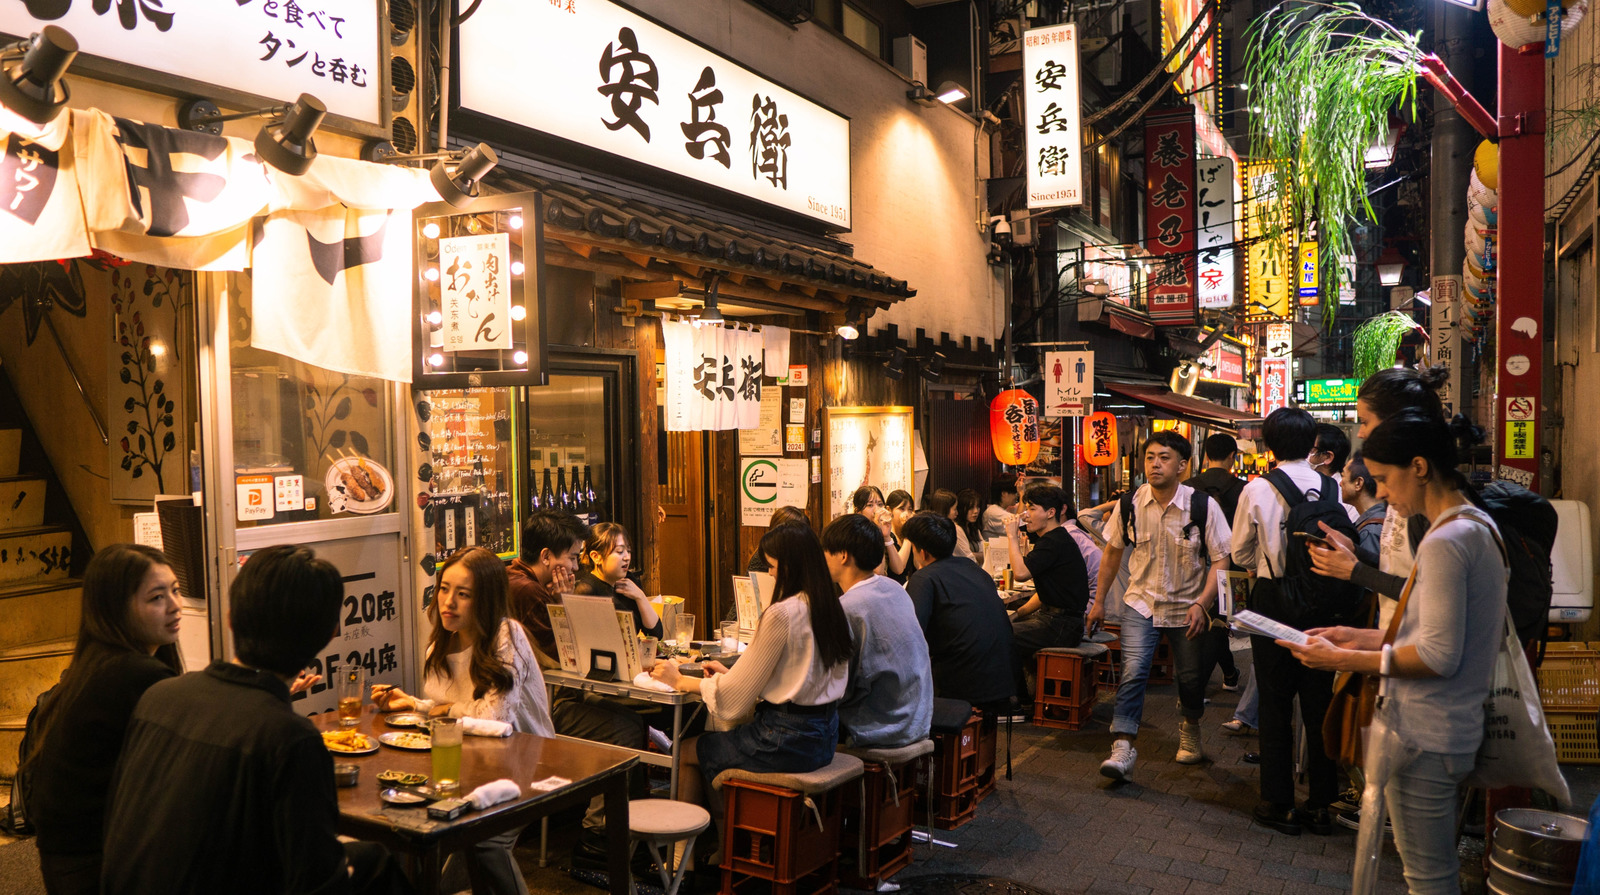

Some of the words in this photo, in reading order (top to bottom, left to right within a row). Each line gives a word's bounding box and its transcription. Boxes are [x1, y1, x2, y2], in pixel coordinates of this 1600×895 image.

[235, 0, 345, 39] と食べて
[1546, 6, 1559, 53] アサヒビール
[1025, 31, 1072, 48] 昭和26年創業
[258, 30, 367, 87] タンと呑む
[597, 26, 791, 190] 安兵衛
[1035, 60, 1069, 178] 安兵衛
[10, 140, 44, 210] サワー
[807, 196, 829, 215] Since
[830, 204, 848, 222] 1951
[1031, 190, 1078, 203] Since1951
[446, 255, 503, 342] おでん
[450, 298, 459, 332] 关东煮
[1154, 295, 1187, 305] 加盟店
[693, 353, 762, 402] 安兵衛
[1057, 387, 1081, 395] トイレ
[1513, 422, 1527, 456] 路上喫煙禁止
[244, 507, 266, 515] PayPay
[344, 590, 396, 627] 20席
[344, 625, 374, 641] お座敷
